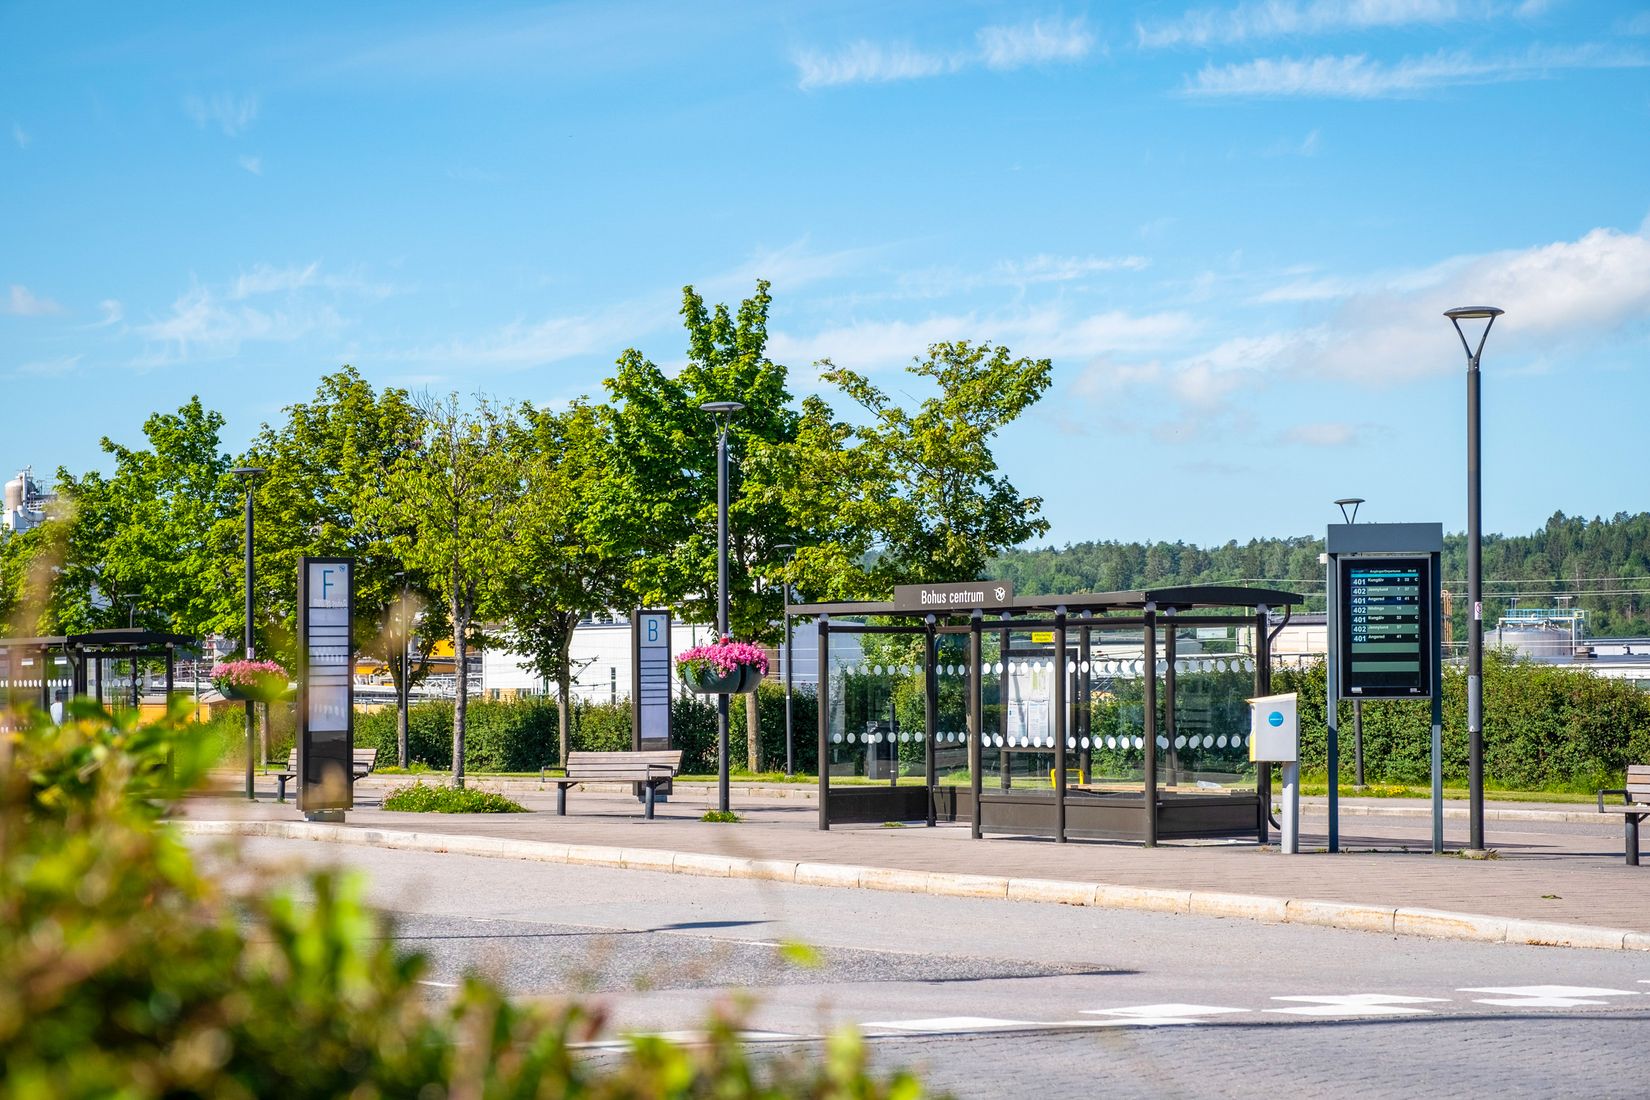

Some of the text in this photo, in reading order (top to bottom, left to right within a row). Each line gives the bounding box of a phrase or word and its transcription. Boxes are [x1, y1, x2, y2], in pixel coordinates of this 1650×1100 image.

[323, 570, 334, 600] F
[921, 590, 984, 605] Bohus centrum
[648, 619, 658, 641] B
